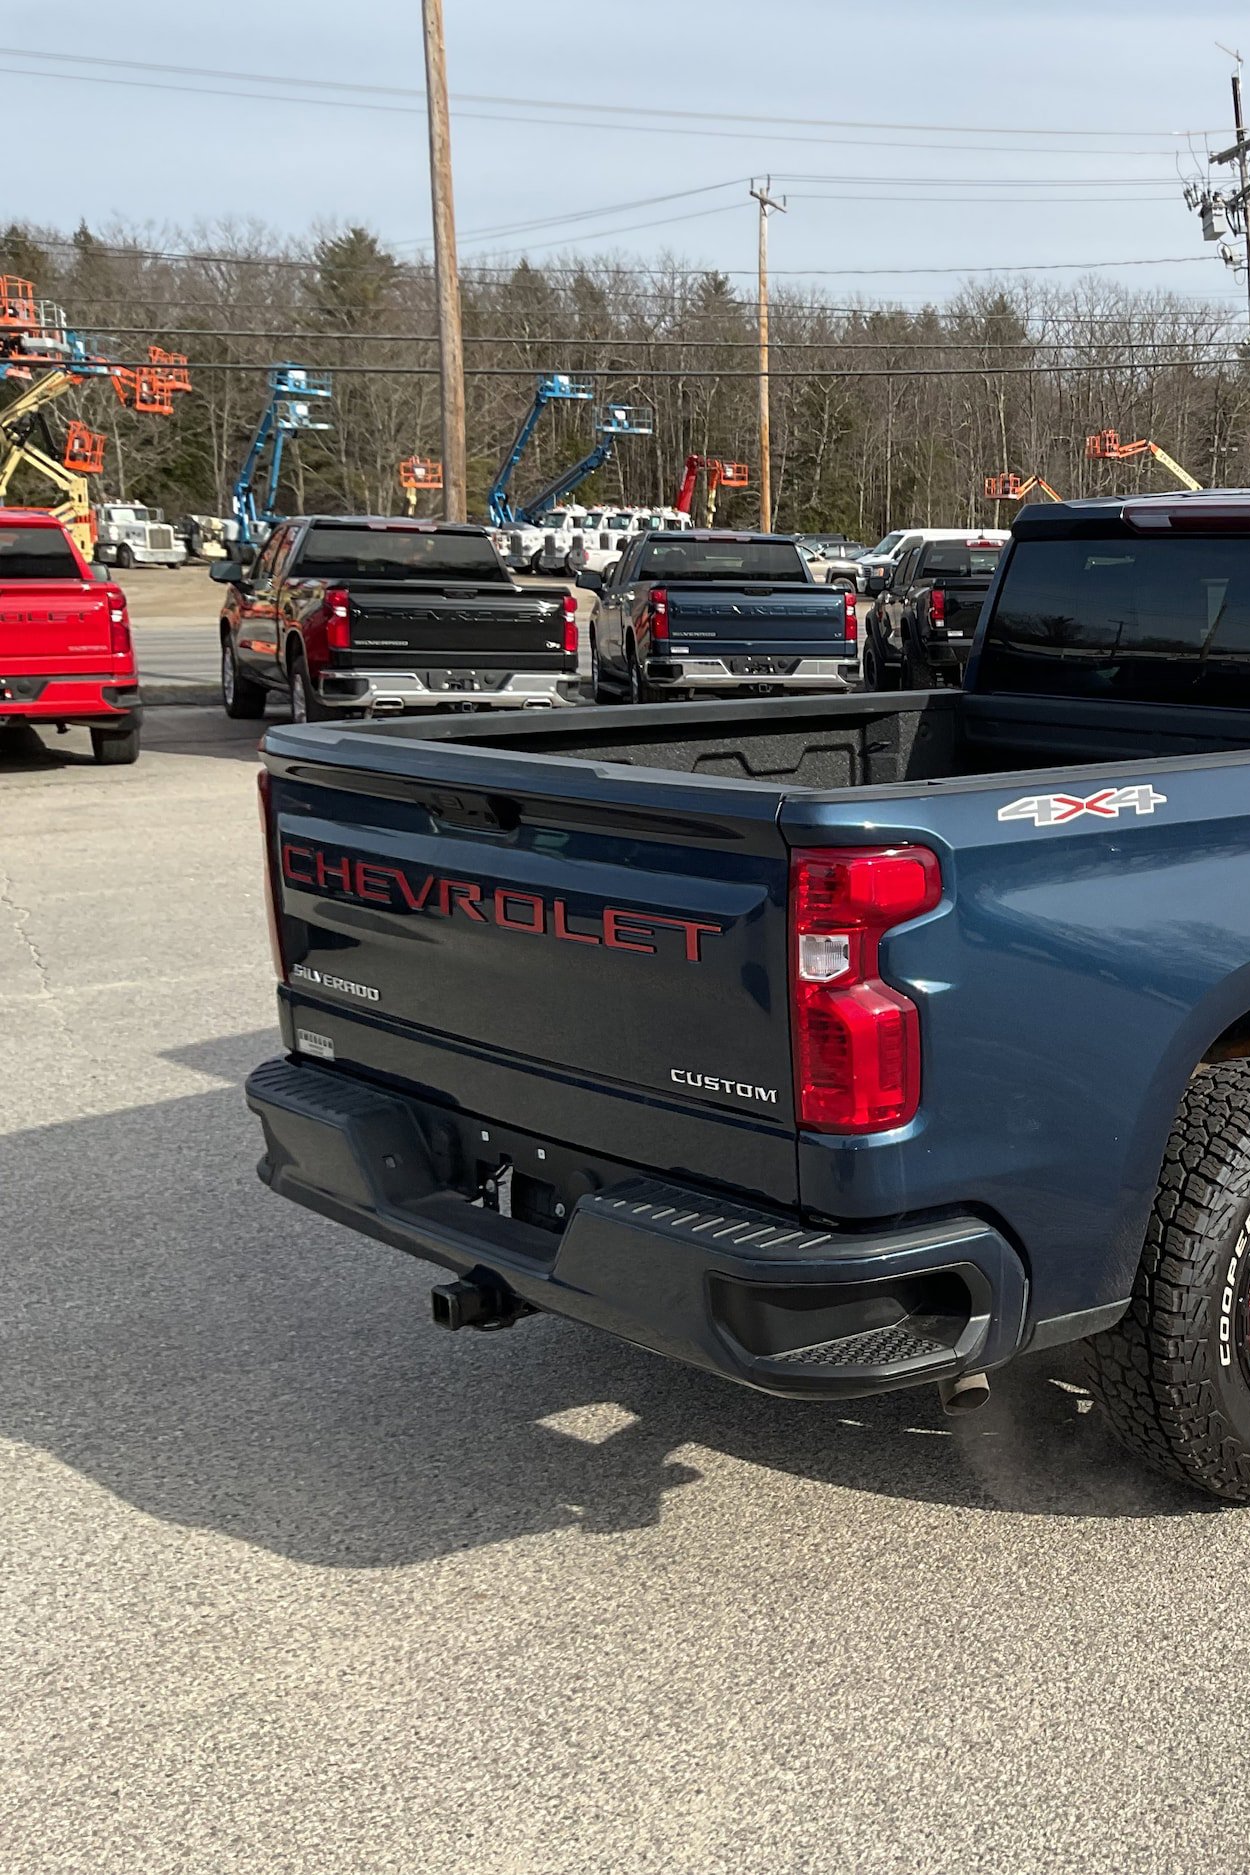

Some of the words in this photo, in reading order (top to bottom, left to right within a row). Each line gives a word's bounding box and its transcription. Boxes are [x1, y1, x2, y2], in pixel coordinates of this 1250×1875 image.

[283, 844, 721, 962] CHEVROLET
[293, 963, 380, 1001] SILVERADO
[670, 1069, 777, 1103] CUSTOM
